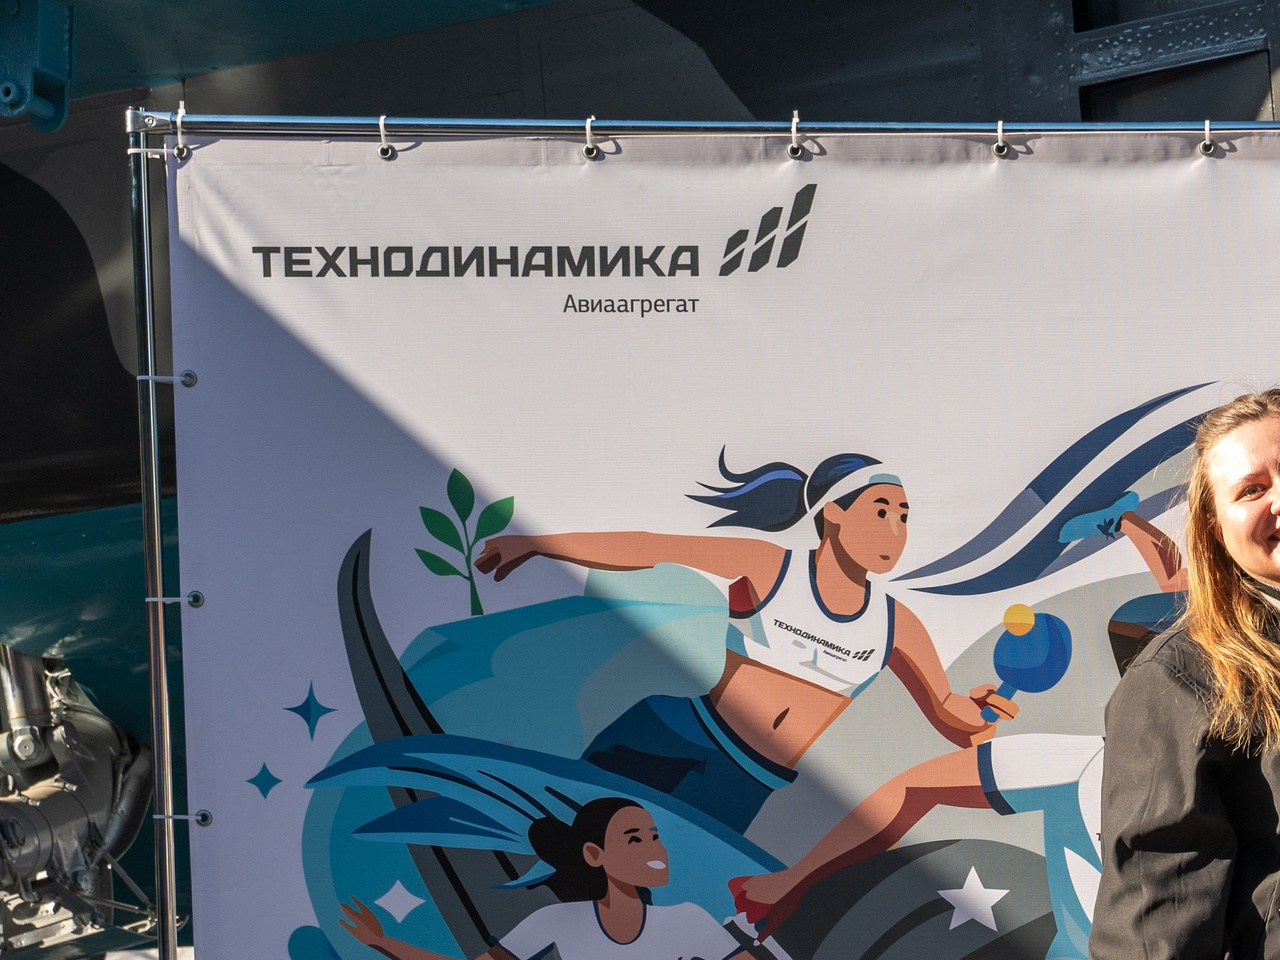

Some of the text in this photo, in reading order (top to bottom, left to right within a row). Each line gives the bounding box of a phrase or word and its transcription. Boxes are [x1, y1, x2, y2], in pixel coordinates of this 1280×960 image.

[252, 245, 700, 278] ТЕХНОДИНАМИКА
[563, 293, 700, 318] Авиаагрегат
[773, 618, 851, 657] ТЕХНОДИНАМИКА
